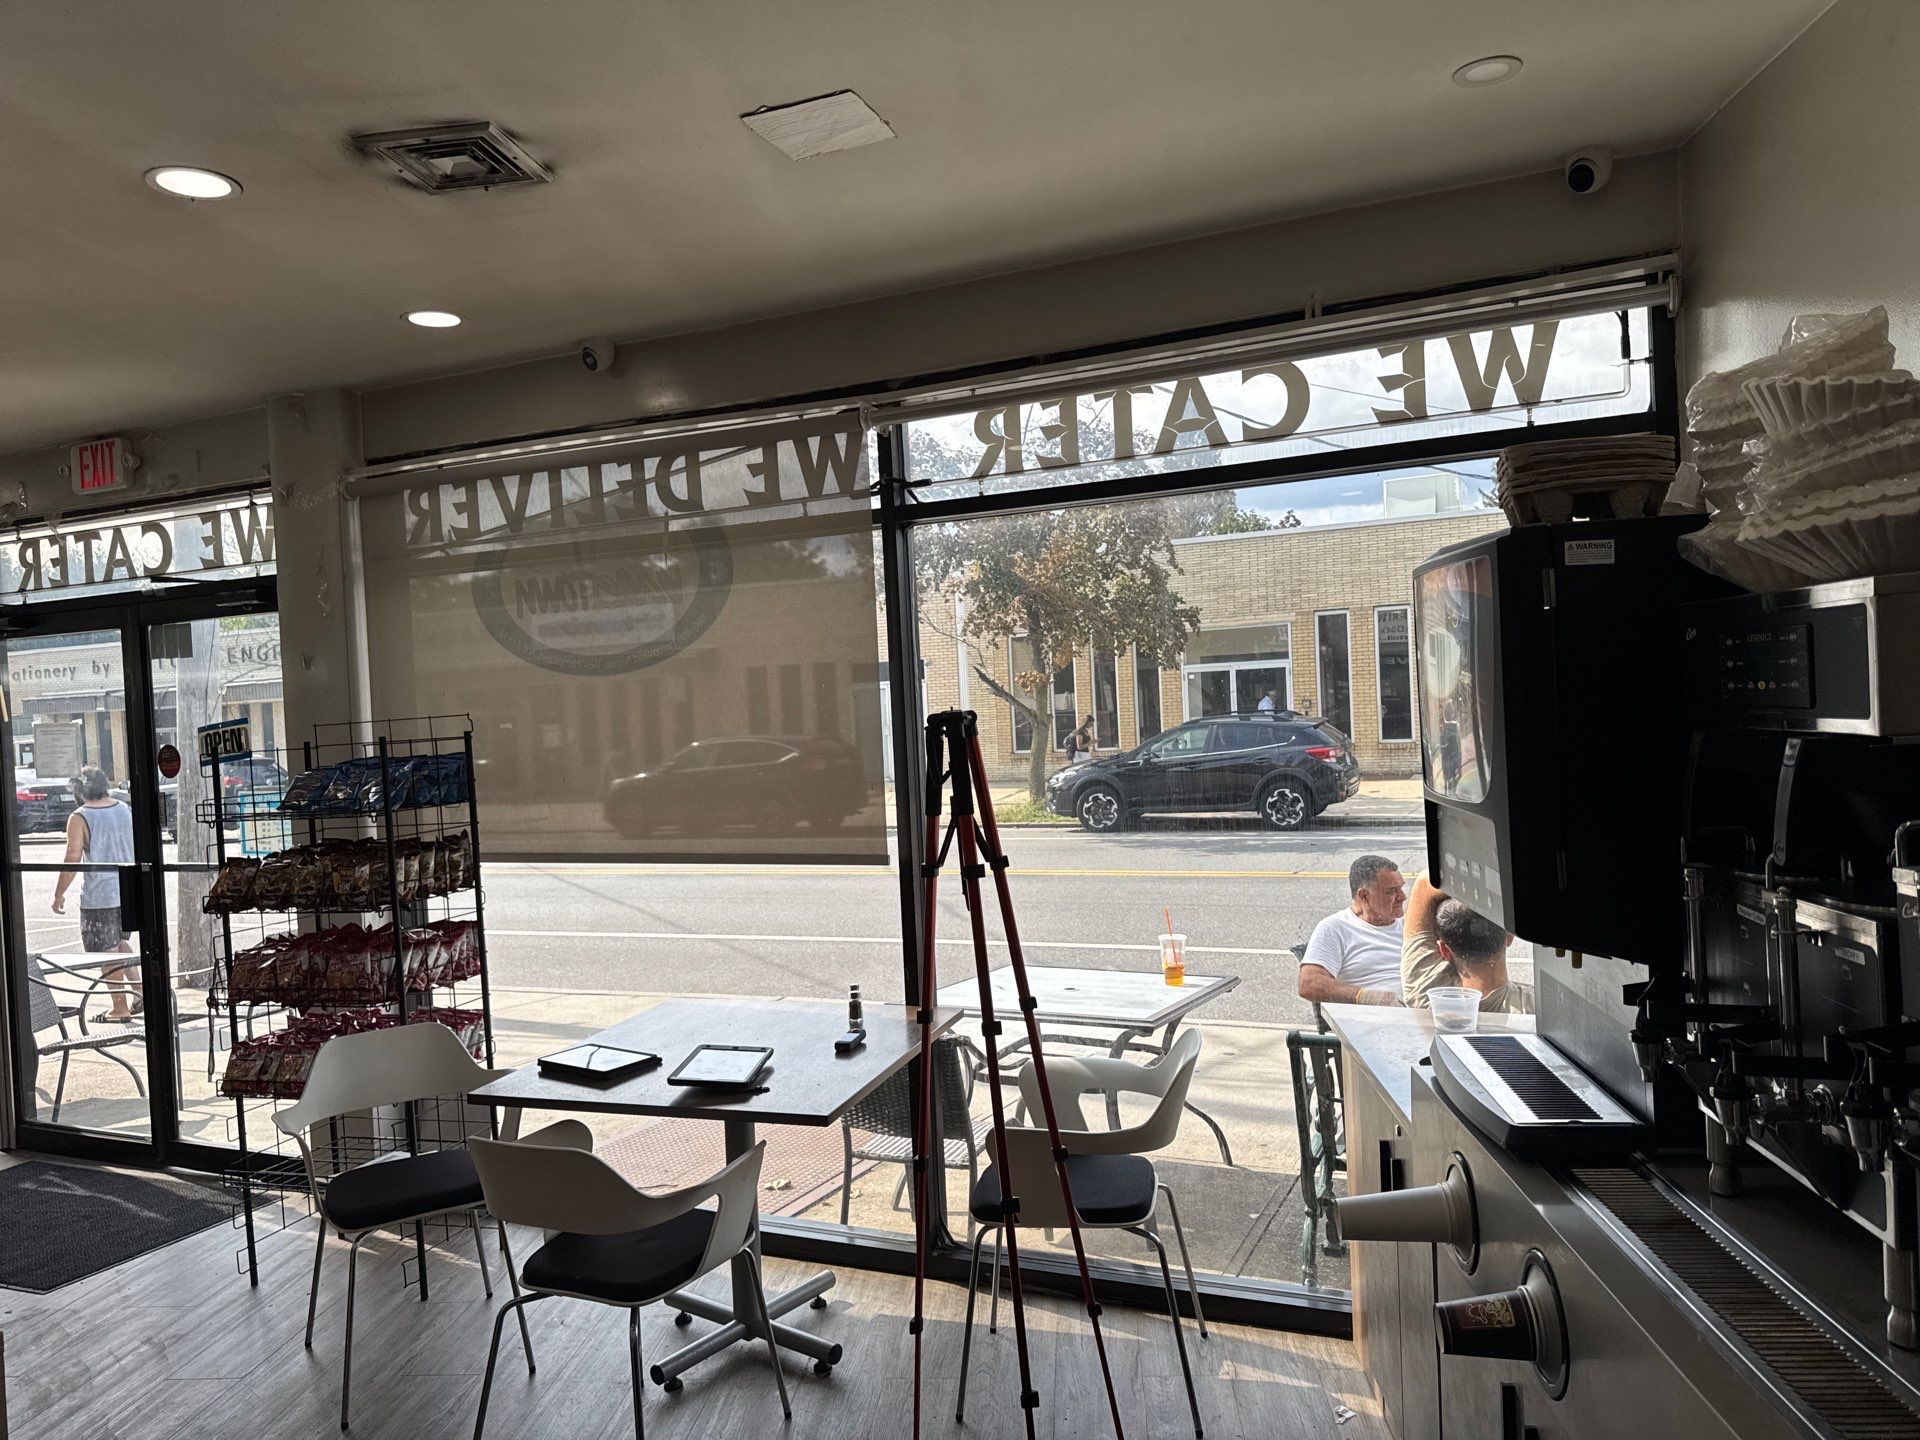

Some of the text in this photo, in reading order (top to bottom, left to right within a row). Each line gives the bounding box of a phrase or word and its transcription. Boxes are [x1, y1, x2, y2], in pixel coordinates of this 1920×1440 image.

[79, 440, 115, 489] EXIT
[1575, 541, 1613, 551] WARNING
[11, 661, 76, 682] ationery
[92, 659, 110, 678] by
[204, 727, 243, 757] OPEN
